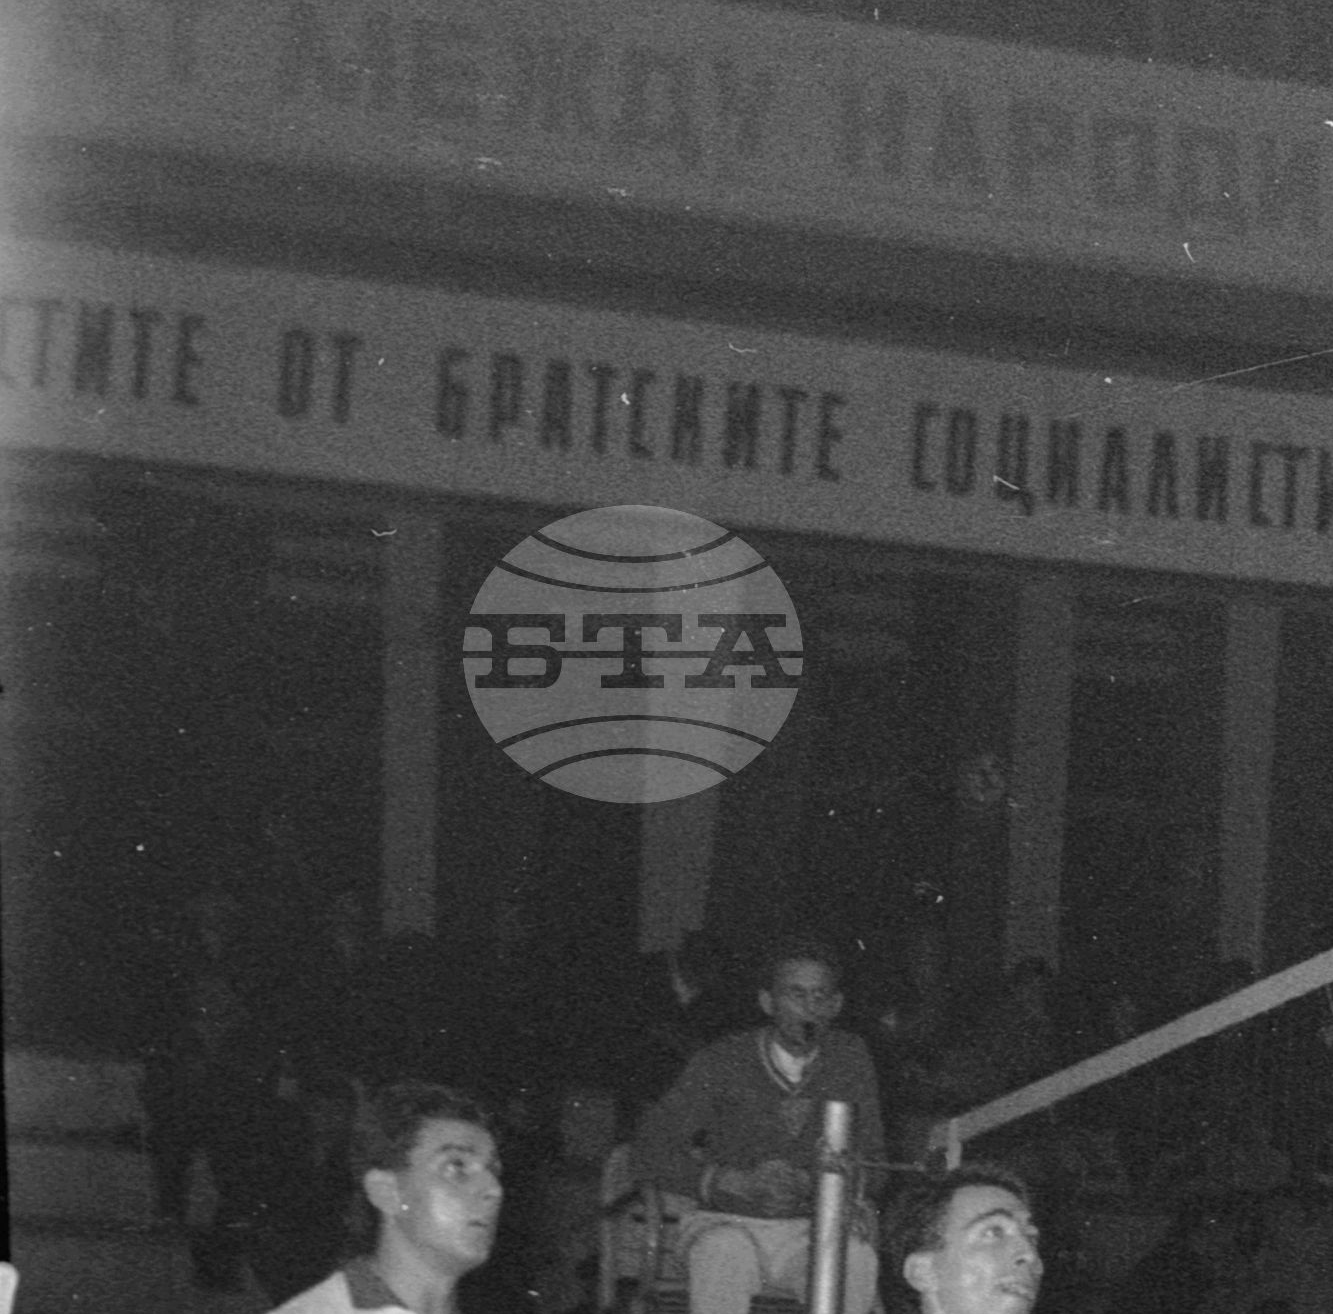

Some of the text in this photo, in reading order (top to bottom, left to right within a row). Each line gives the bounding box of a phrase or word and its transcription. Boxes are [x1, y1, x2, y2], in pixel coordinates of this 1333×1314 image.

[276, 2, 775, 166] МЕЖДУ
[277, 327, 365, 424] ОТ
[434, 346, 849, 482] БРАТСКИТЕ
